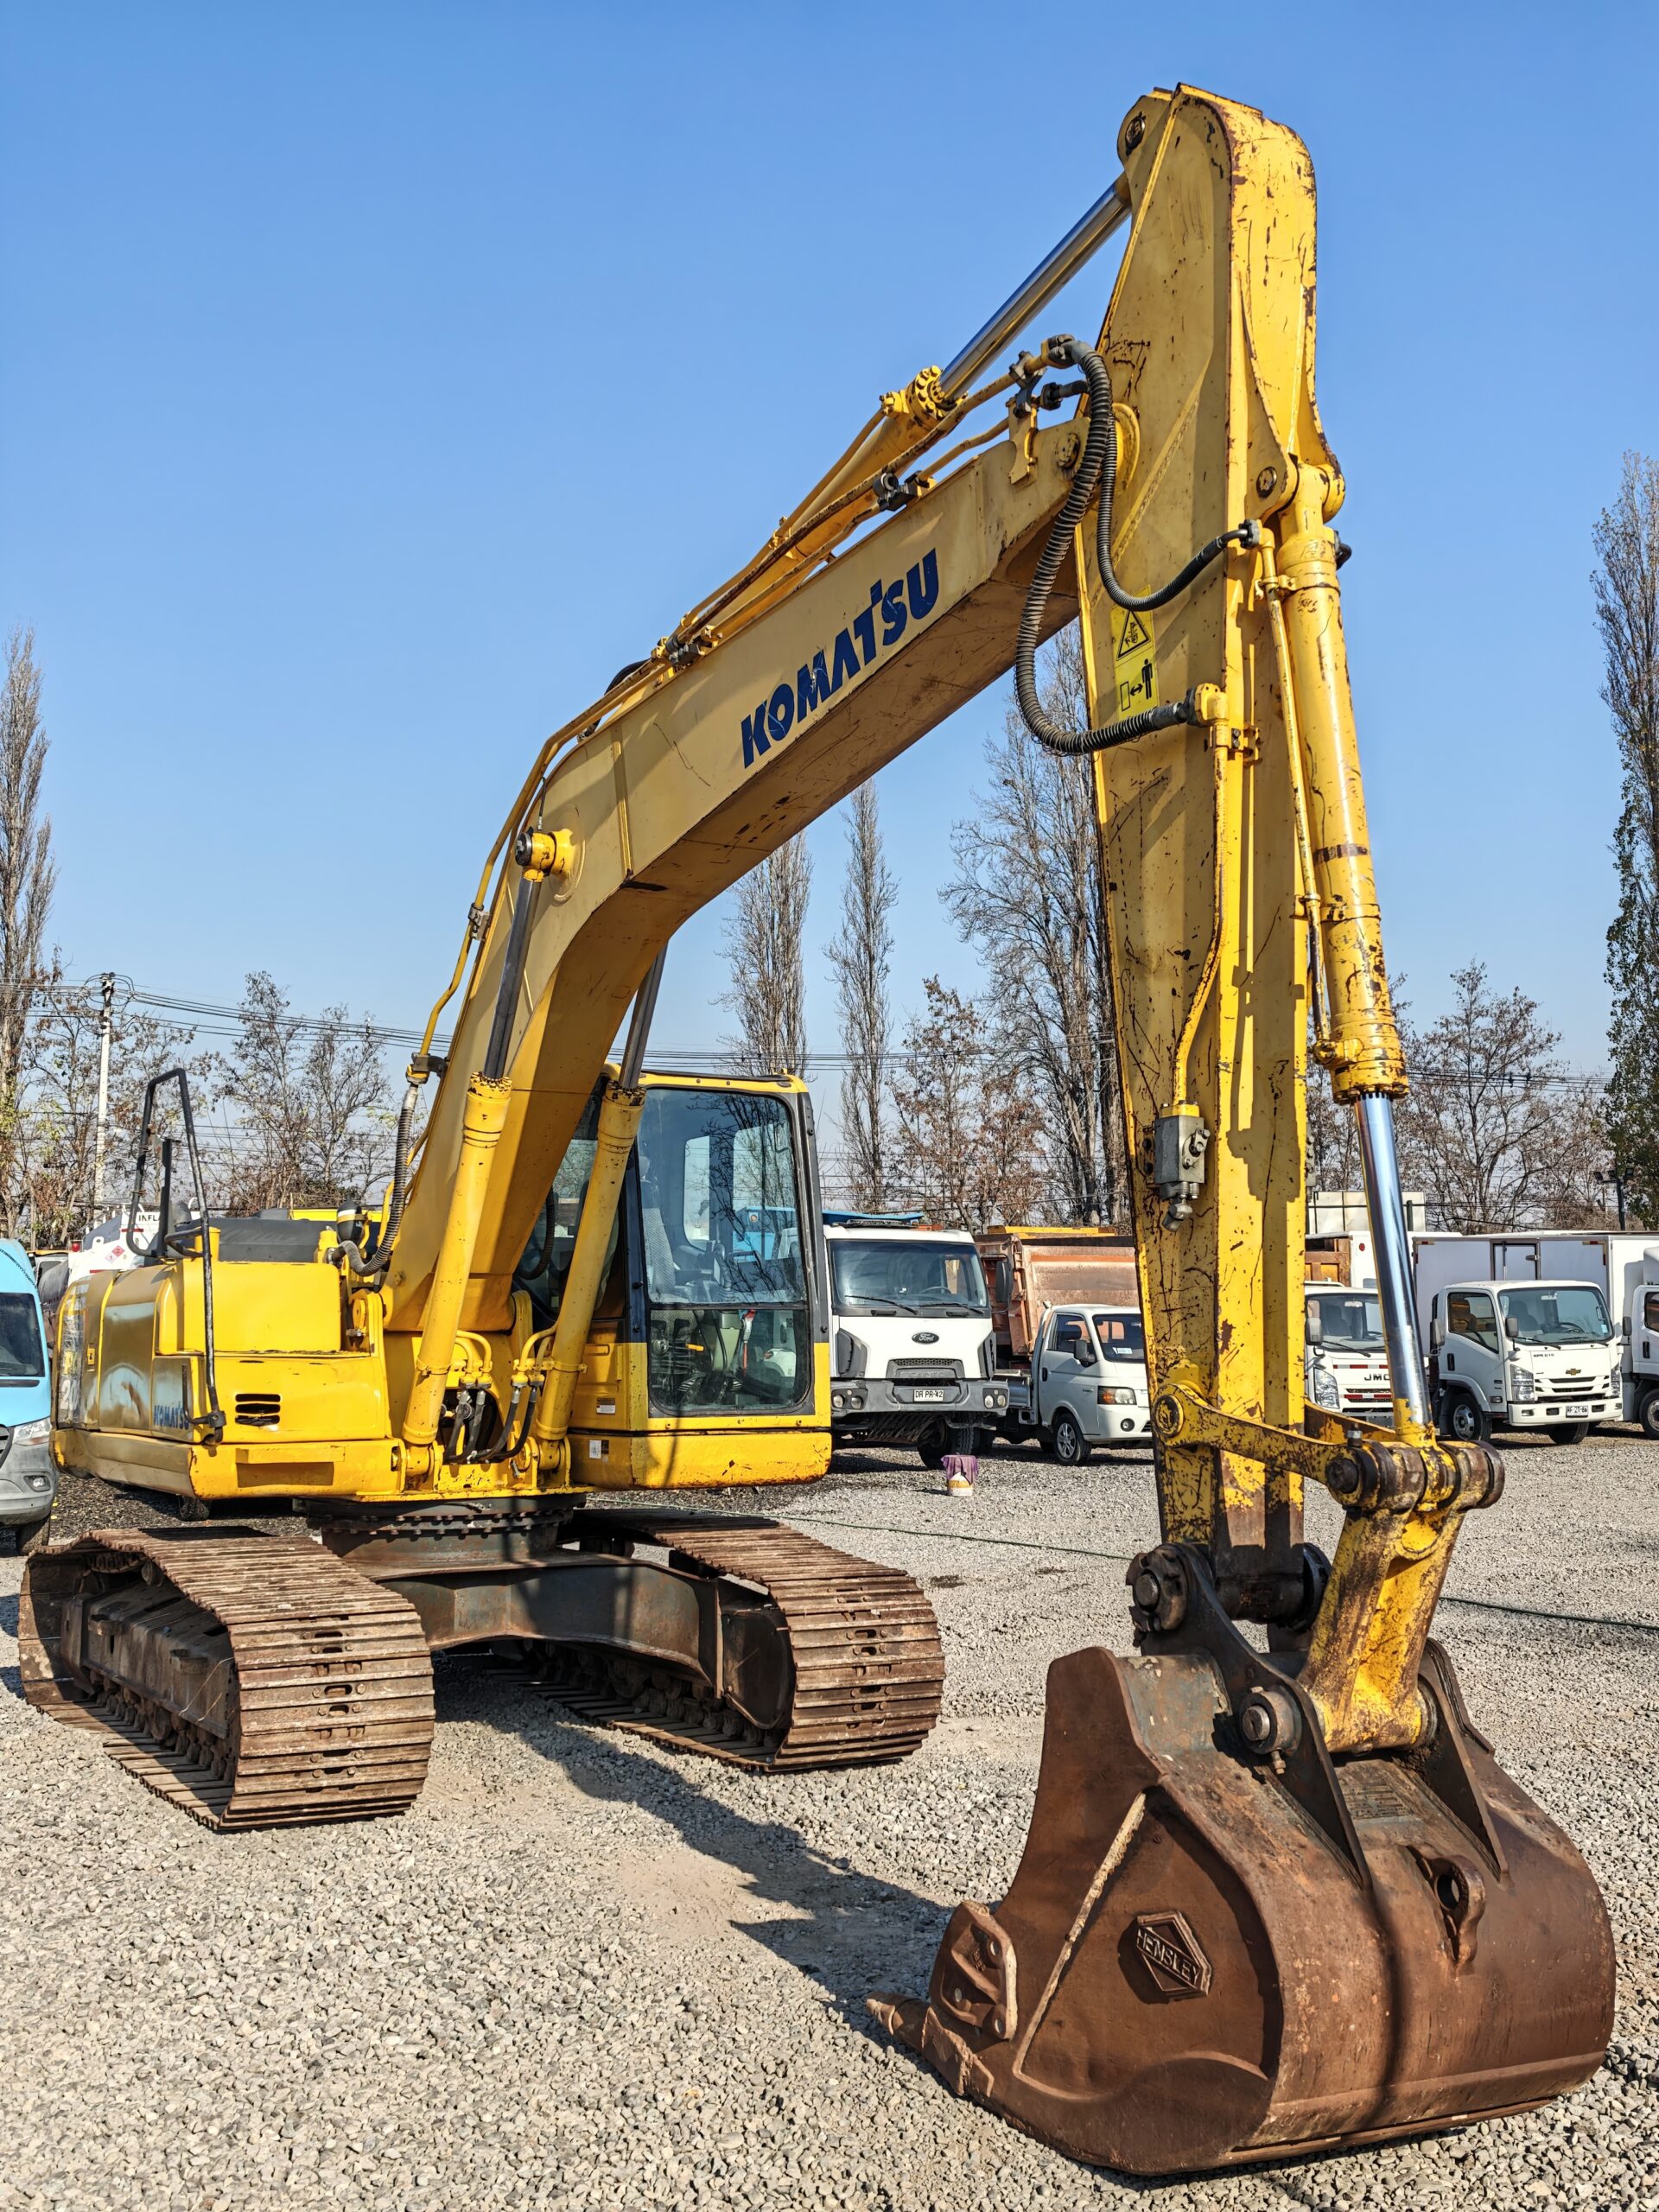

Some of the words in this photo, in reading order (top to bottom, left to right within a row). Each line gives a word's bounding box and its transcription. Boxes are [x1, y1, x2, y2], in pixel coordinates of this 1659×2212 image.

[741, 548, 939, 769] KOMATSU
[917, 1332, 936, 1343] Ford
[1137, 1928, 1200, 1986] HENSLEY
